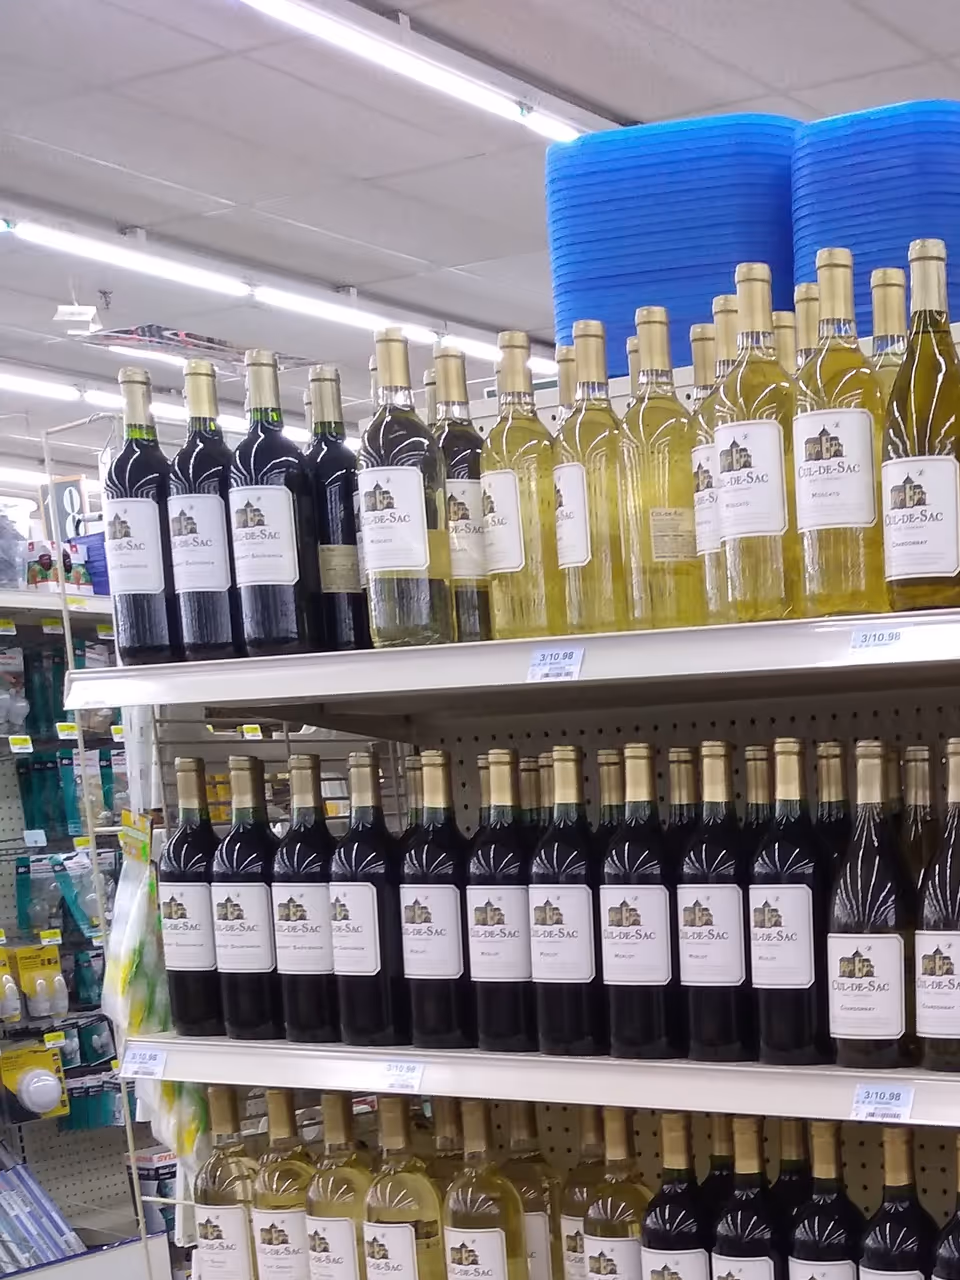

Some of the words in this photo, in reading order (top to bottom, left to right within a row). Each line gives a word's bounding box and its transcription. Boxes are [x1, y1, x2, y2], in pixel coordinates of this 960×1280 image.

[798, 462, 861, 478] CUL-DE-SAC
[885, 510, 943, 526] CUL-DE-SAC
[861, 632, 901, 643] 3/10.98
[831, 980, 889, 992] CUL-DE-SAC
[864, 1091, 901, 1101] 3/10.98
